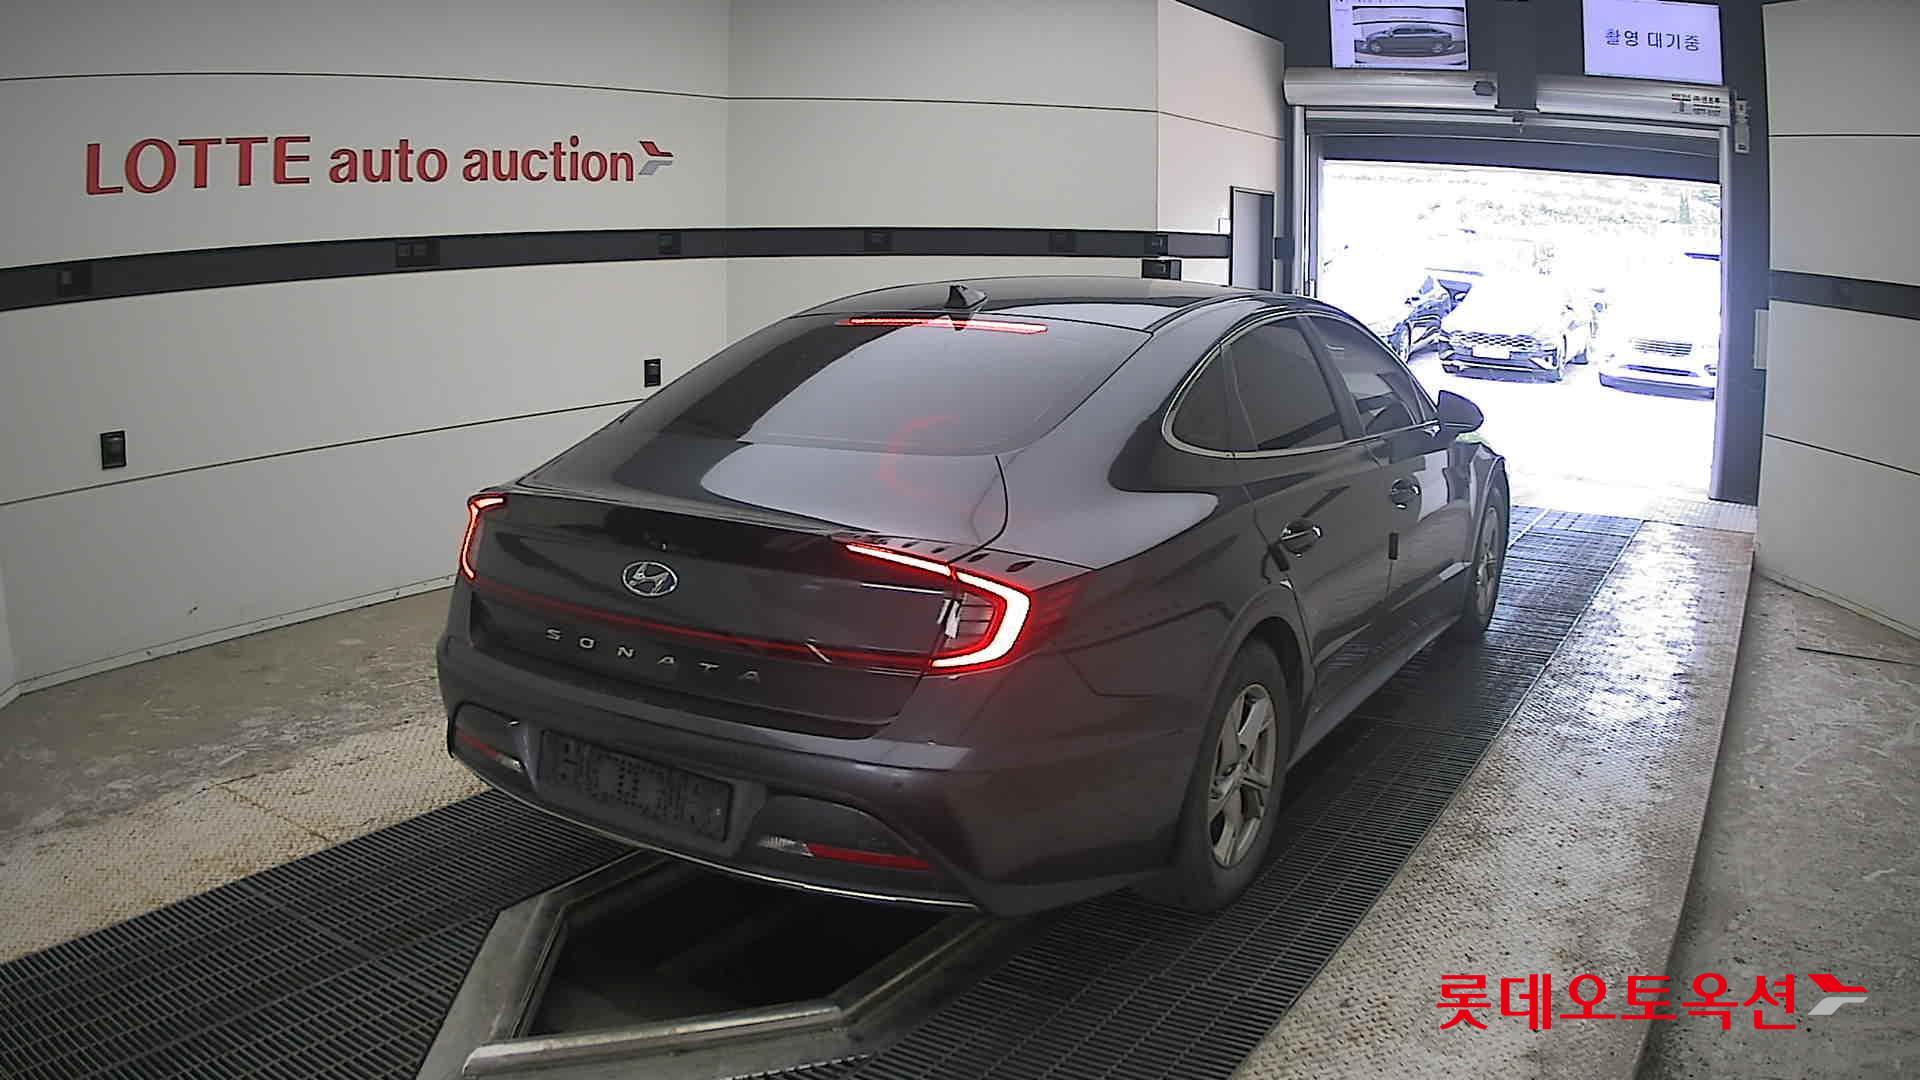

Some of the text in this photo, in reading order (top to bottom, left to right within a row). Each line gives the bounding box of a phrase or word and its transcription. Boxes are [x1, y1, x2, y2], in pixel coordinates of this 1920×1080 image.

[1647, 31, 1700, 52] 대기중
[85, 134, 636, 196] LOTTE auto auction
[545, 627, 761, 684] SONATA
